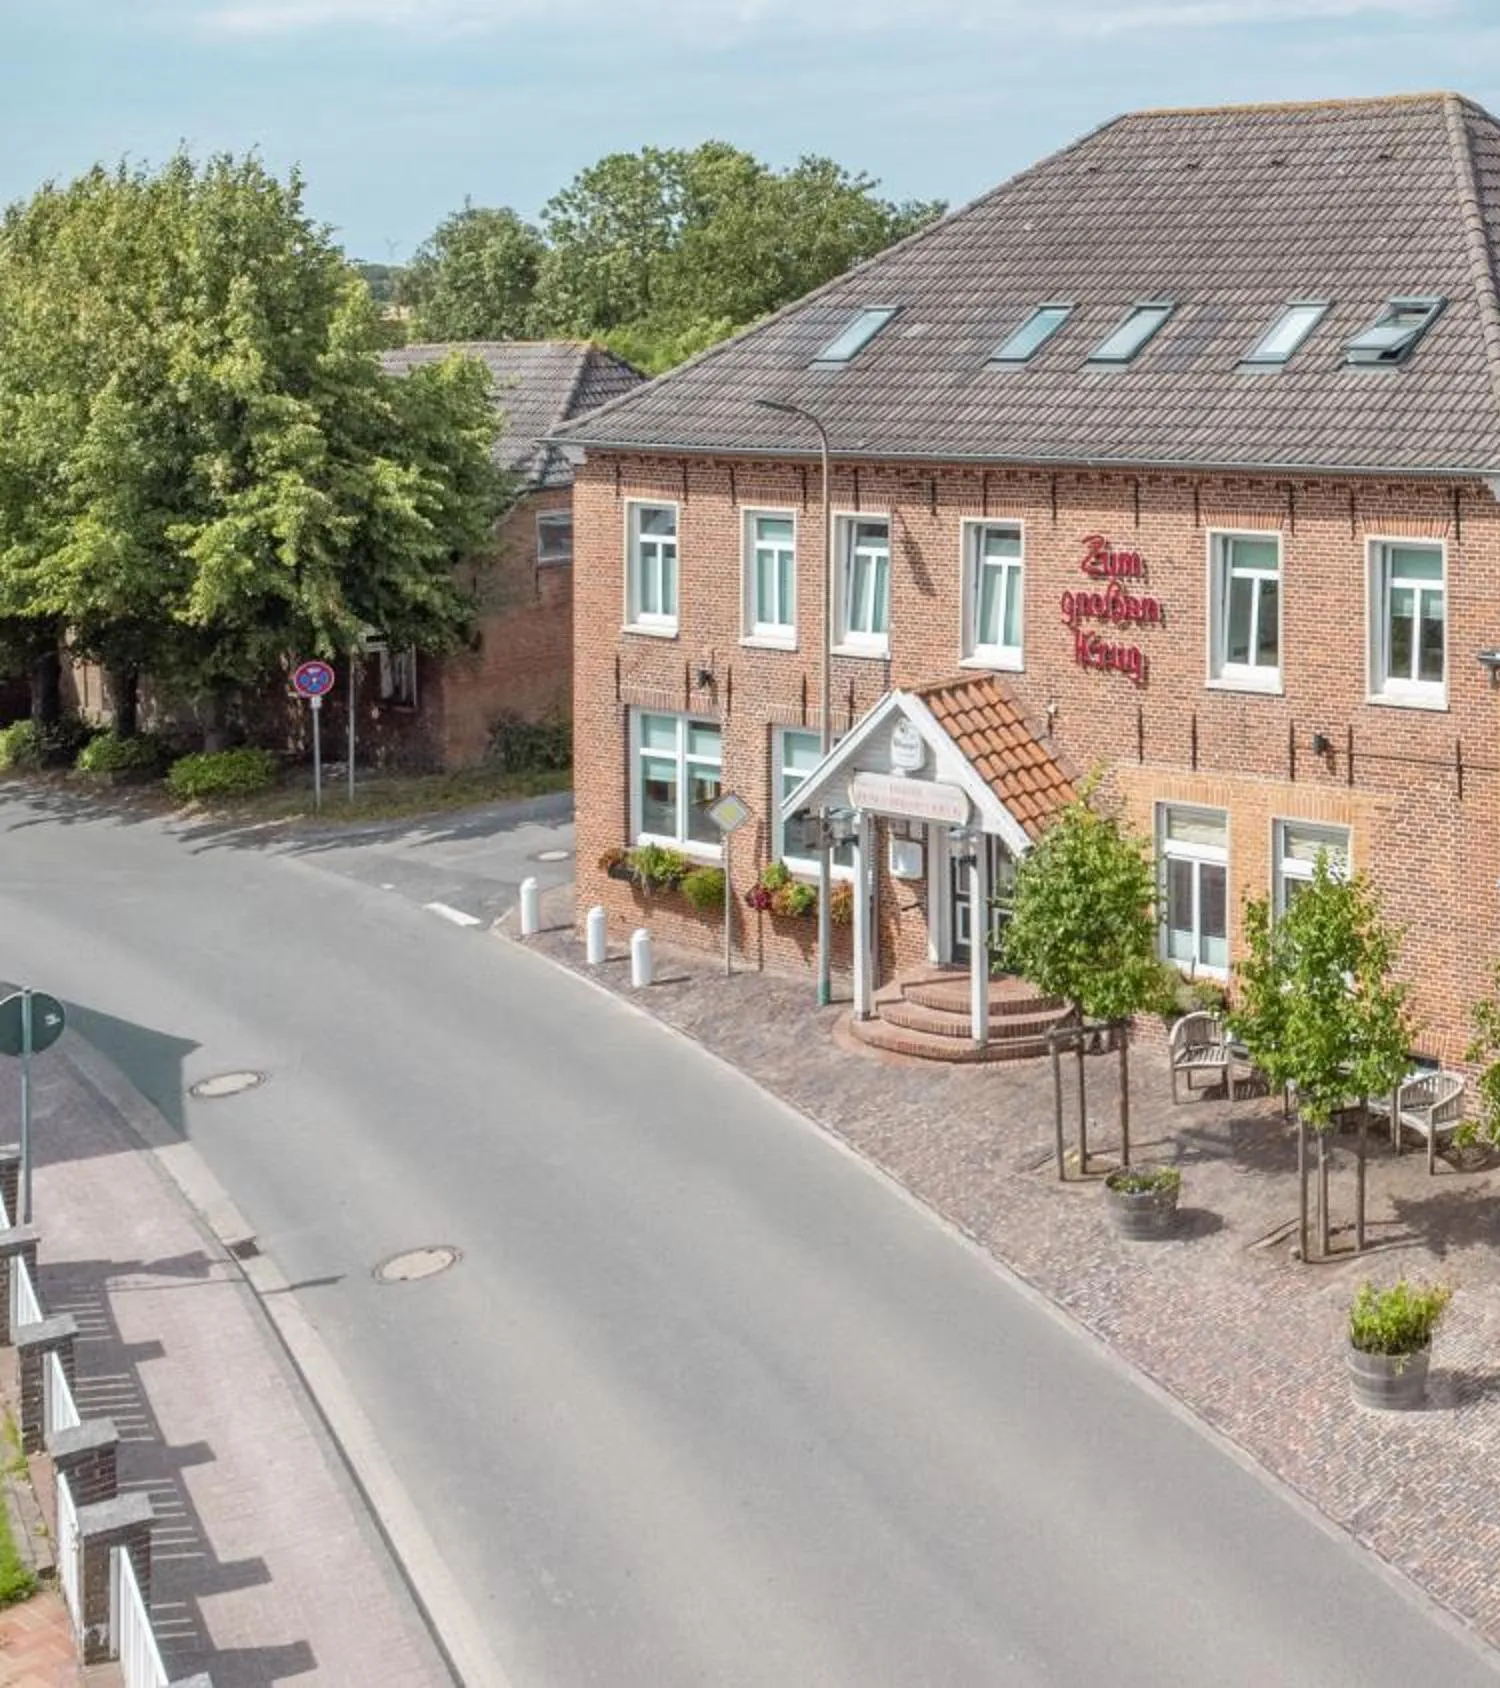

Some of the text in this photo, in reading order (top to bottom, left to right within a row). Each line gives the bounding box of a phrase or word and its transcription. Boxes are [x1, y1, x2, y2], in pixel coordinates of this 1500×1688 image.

[1082, 535, 1142, 577] Zum
[1061, 581, 1160, 625] großen
[1075, 630, 1142, 681] Krug
